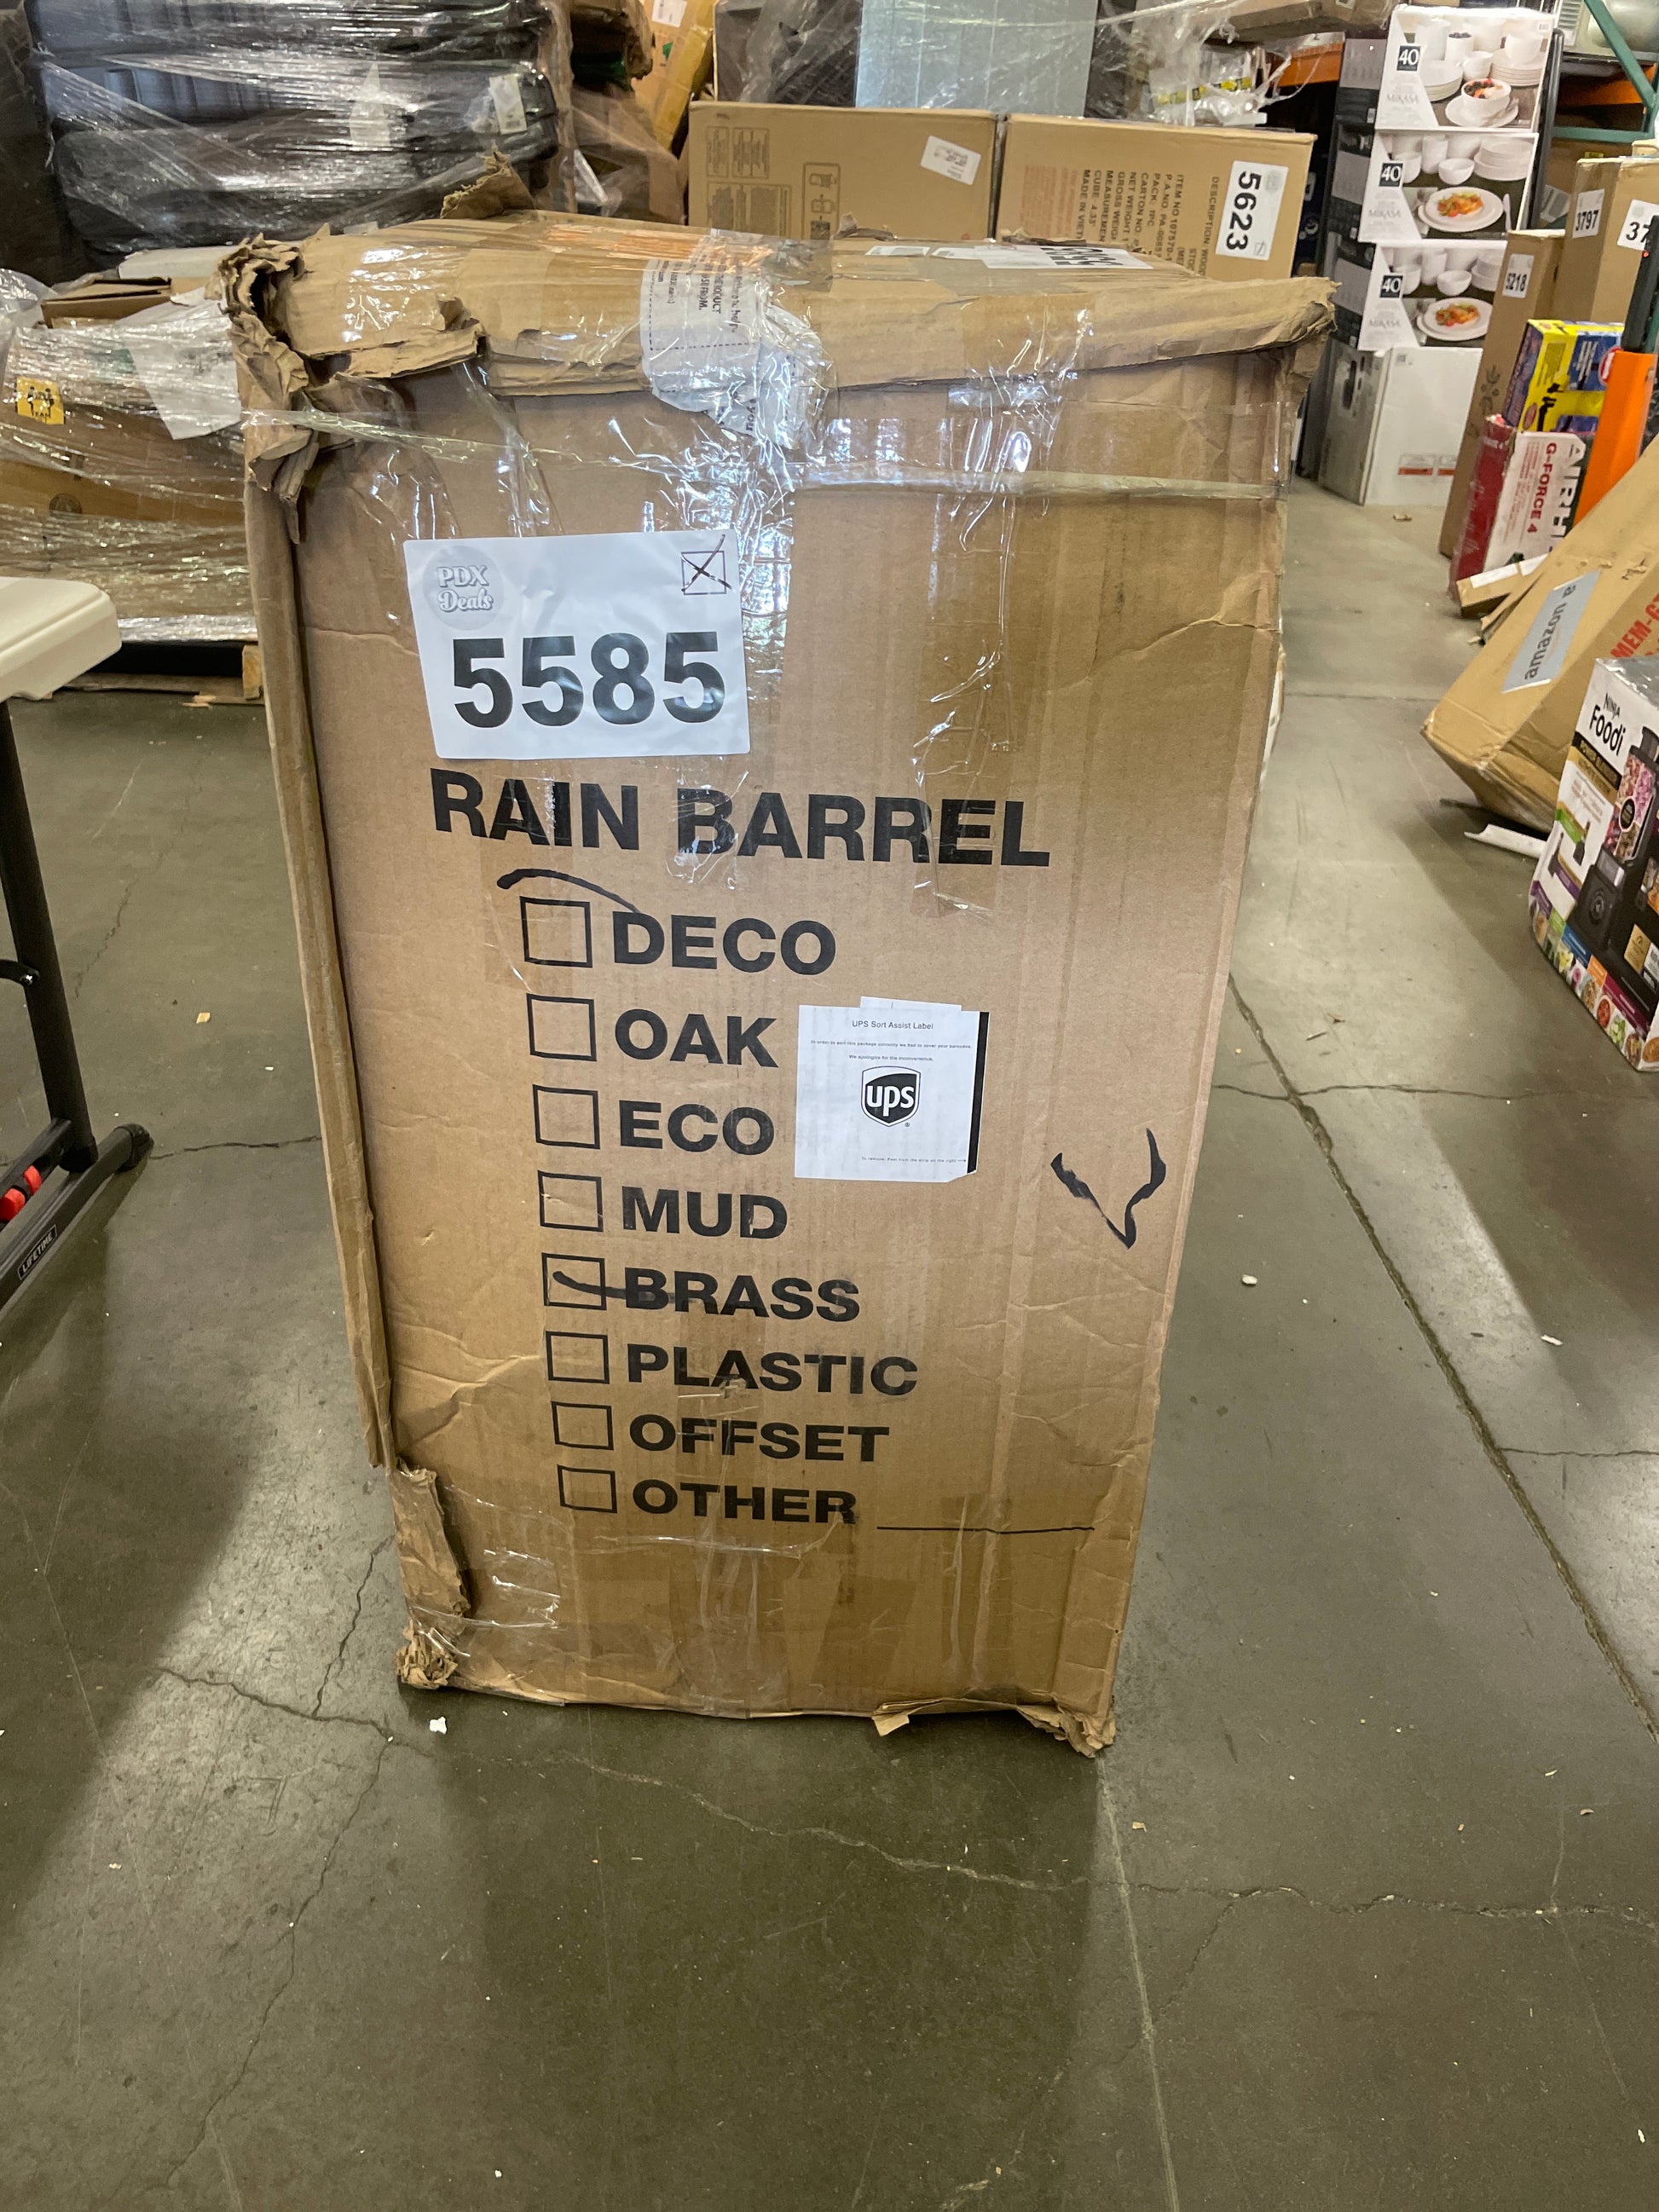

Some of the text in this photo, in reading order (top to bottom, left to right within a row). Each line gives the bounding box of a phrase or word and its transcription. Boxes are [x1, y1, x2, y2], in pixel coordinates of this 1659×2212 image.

[1399, 49, 1419, 66] 40
[1080, 170, 1090, 199] MADE
[1114, 171, 1125, 208] GROSS
[1136, 172, 1149, 216] CARTON
[1175, 175, 1184, 199] ITEM
[1381, 165, 1402, 182] 40
[1078, 202, 1086, 212] IN
[1226, 171, 1262, 250] 5623
[1575, 210, 1599, 231] 3797
[1382, 278, 1402, 293] 40
[1530, 442, 1557, 520] G-FORCE
[437, 564, 490, 588] PDX
[437, 588, 494, 613] Deals
[1524, 603, 1567, 680] amazon
[453, 631, 725, 729] 5585
[1604, 692, 1621, 721] NINJA
[1589, 704, 1627, 756] Foodi
[430, 768, 1050, 867] RAIN BARREL
[612, 911, 836, 976] DECO
[614, 1008, 779, 1069] OAK
[888, 1021, 910, 1030] Assist
[866, 1085, 915, 1117] ups
[619, 1100, 775, 1156] ECO
[622, 1186, 789, 1239] MUD
[22, 1231, 54, 1273] LIFETIME
[624, 1267, 860, 1322] BRASS
[627, 1343, 919, 1396] PLASTIC
[629, 1413, 890, 1463] OFFSET
[632, 1478, 857, 1525] OTHER
